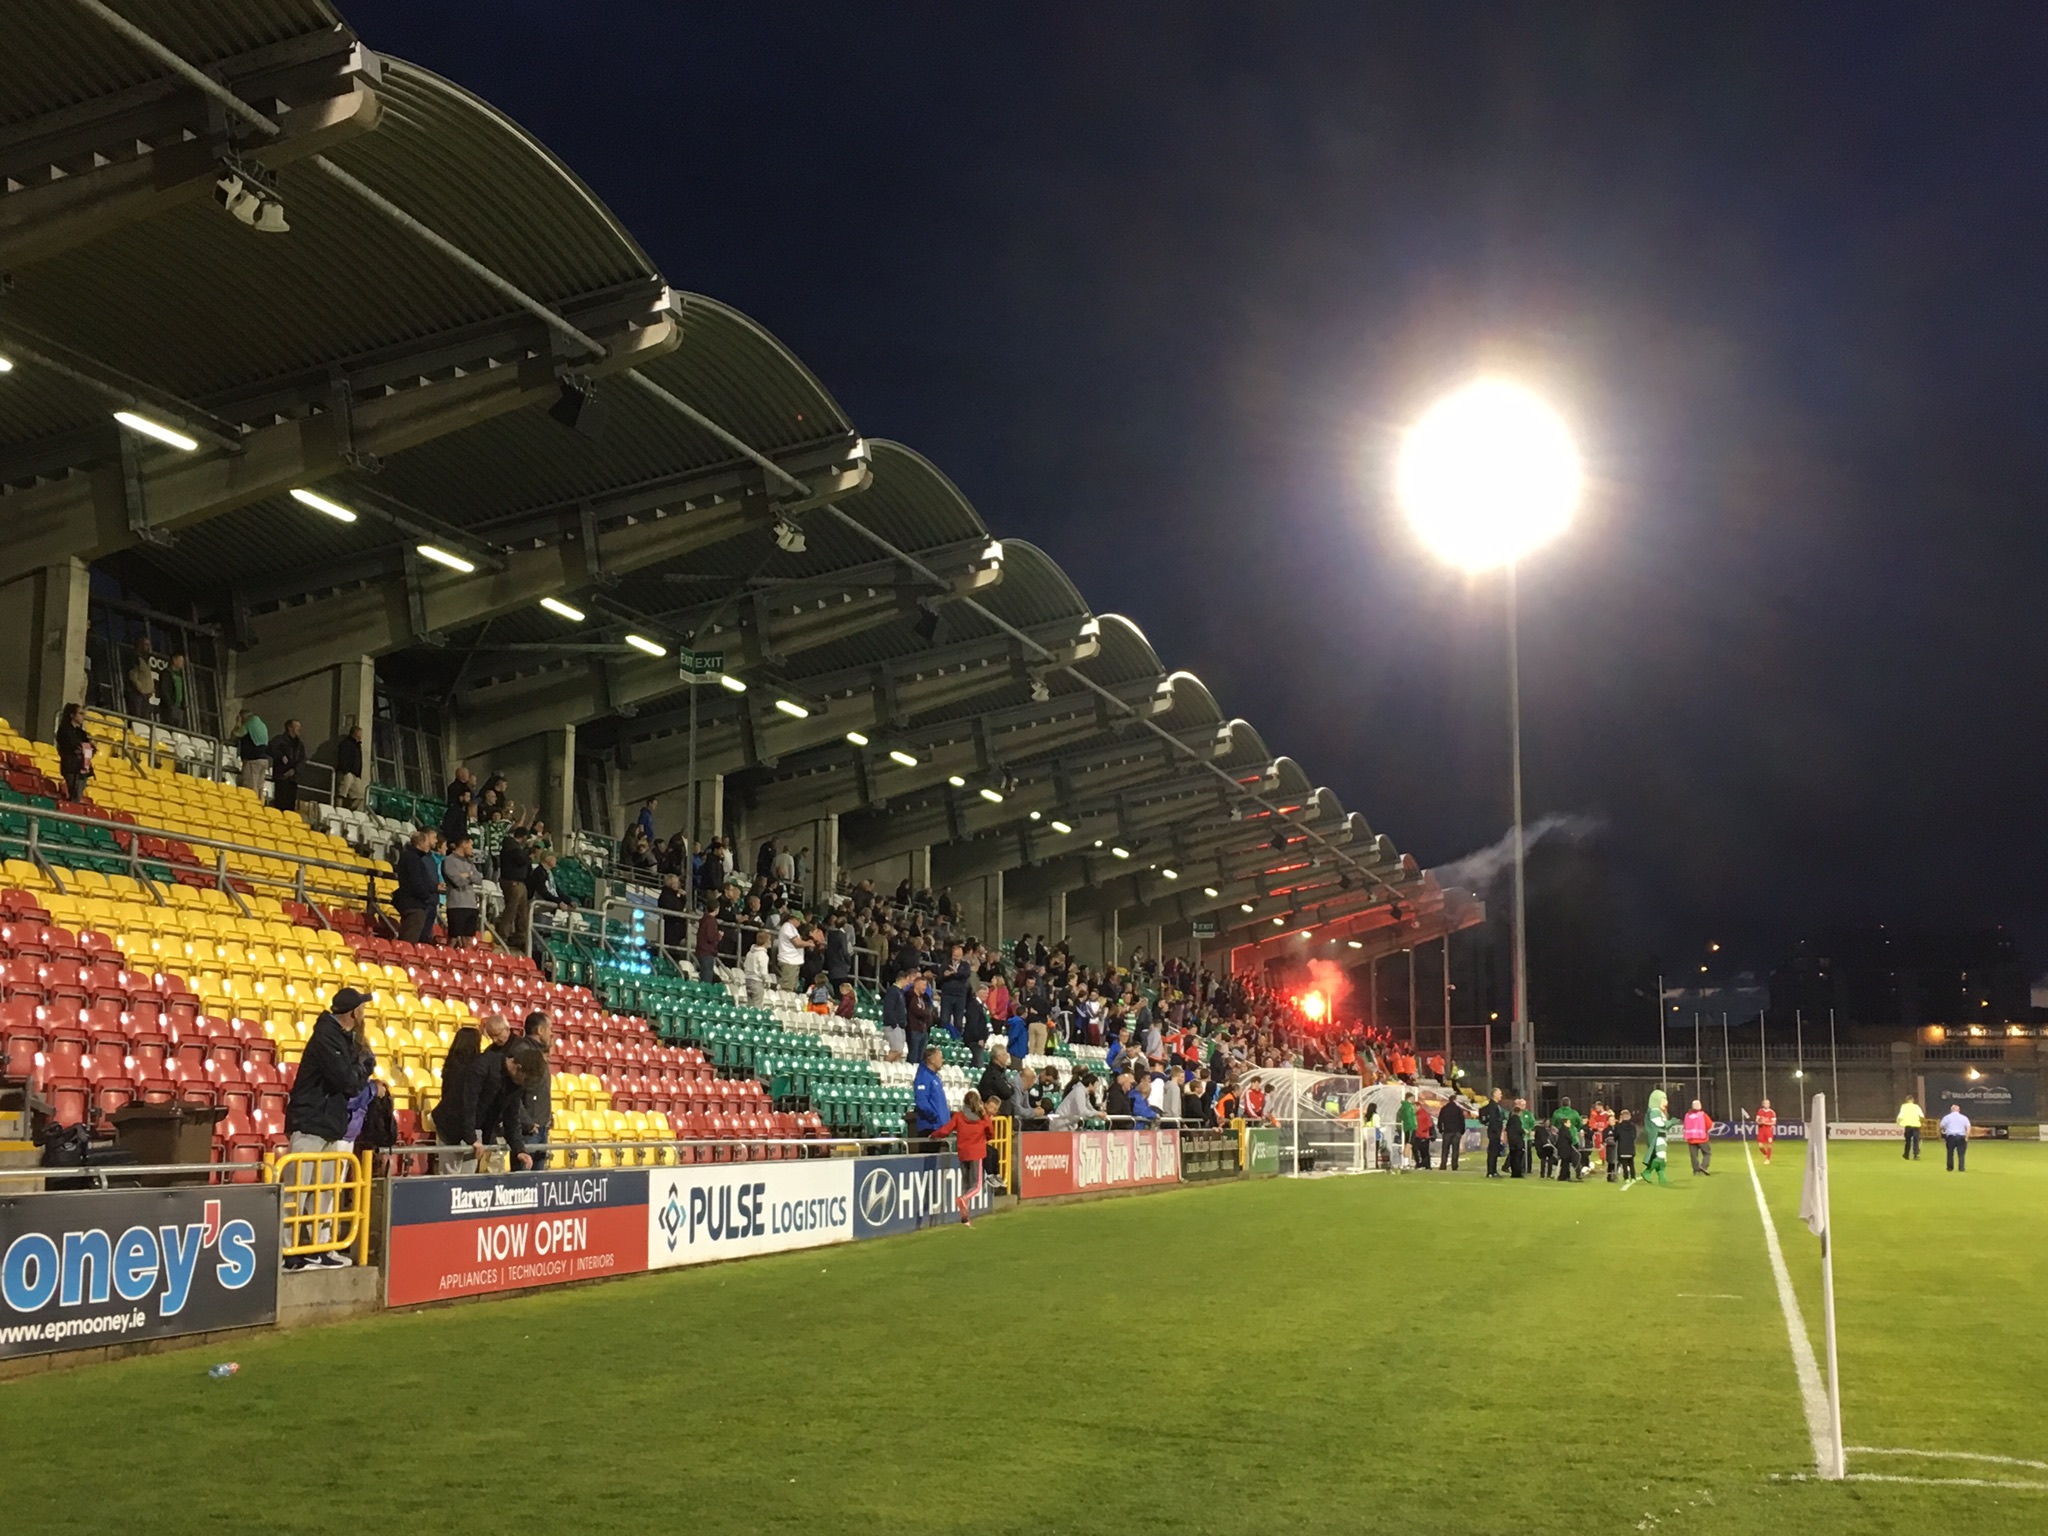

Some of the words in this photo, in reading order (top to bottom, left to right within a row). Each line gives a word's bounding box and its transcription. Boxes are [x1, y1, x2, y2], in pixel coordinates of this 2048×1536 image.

[695, 656, 722, 668] EXIT
[1734, 1124, 1803, 1136] HYDAI
[1835, 1128, 1857, 1136] new
[1079, 1134, 1103, 1188] STAR
[1106, 1132, 1129, 1185] STAR
[1133, 1131, 1153, 1181] STAR
[1156, 1131, 1175, 1179] STAR
[451, 1187, 493, 1212] Harvey
[494, 1184, 538, 1206] Norman
[542, 1178, 608, 1206] TALLAGHT
[689, 1182, 766, 1244] PULSE
[772, 1196, 847, 1234] LOGISTICS
[477, 1222, 528, 1262] NOW
[535, 1217, 587, 1255] OPEN
[439, 1272, 498, 1290] APPLIANCES
[508, 1260, 566, 1281] TECHNOLOGY
[577, 1253, 614, 1271] INTERIORS
